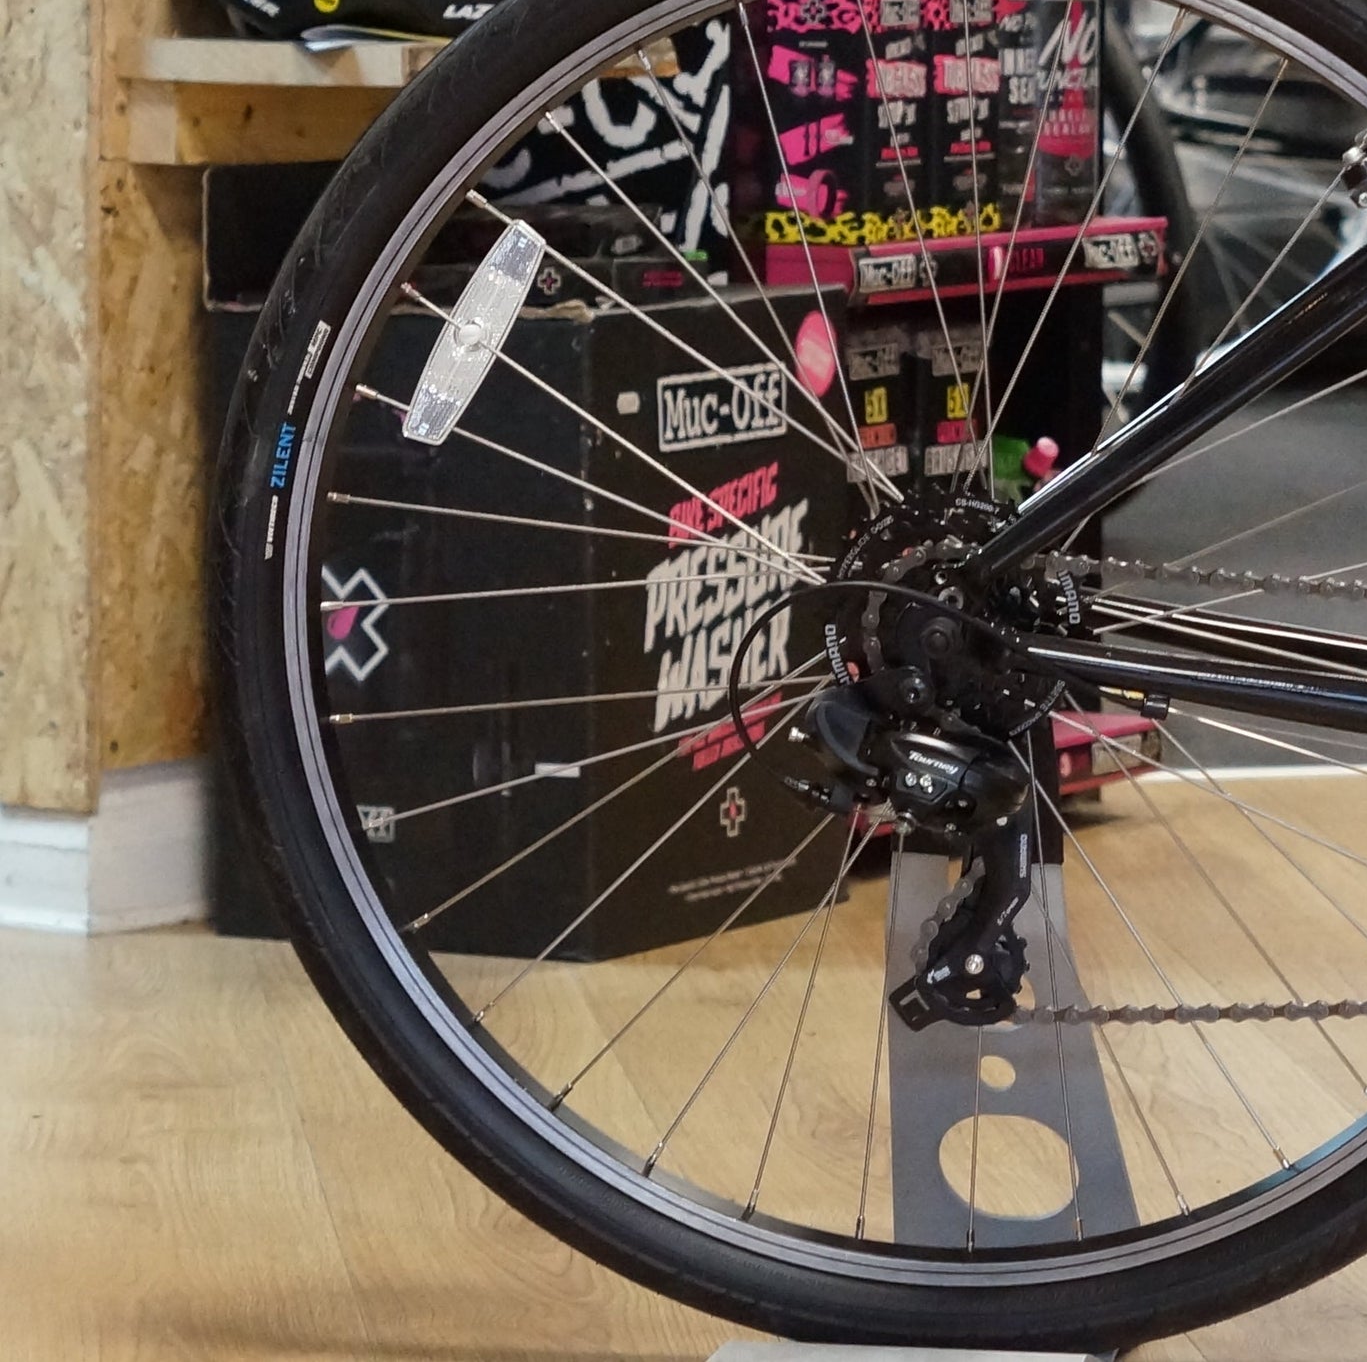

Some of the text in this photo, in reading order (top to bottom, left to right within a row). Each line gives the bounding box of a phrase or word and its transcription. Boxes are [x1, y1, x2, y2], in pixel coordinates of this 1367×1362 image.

[664, 373, 782, 440] Muc-Off
[270, 422, 297, 489] ZILENT
[706, 461, 780, 534] SPECIFIC
[643, 497, 810, 655] PRESSURE
[908, 749, 959, 775] Tourney
